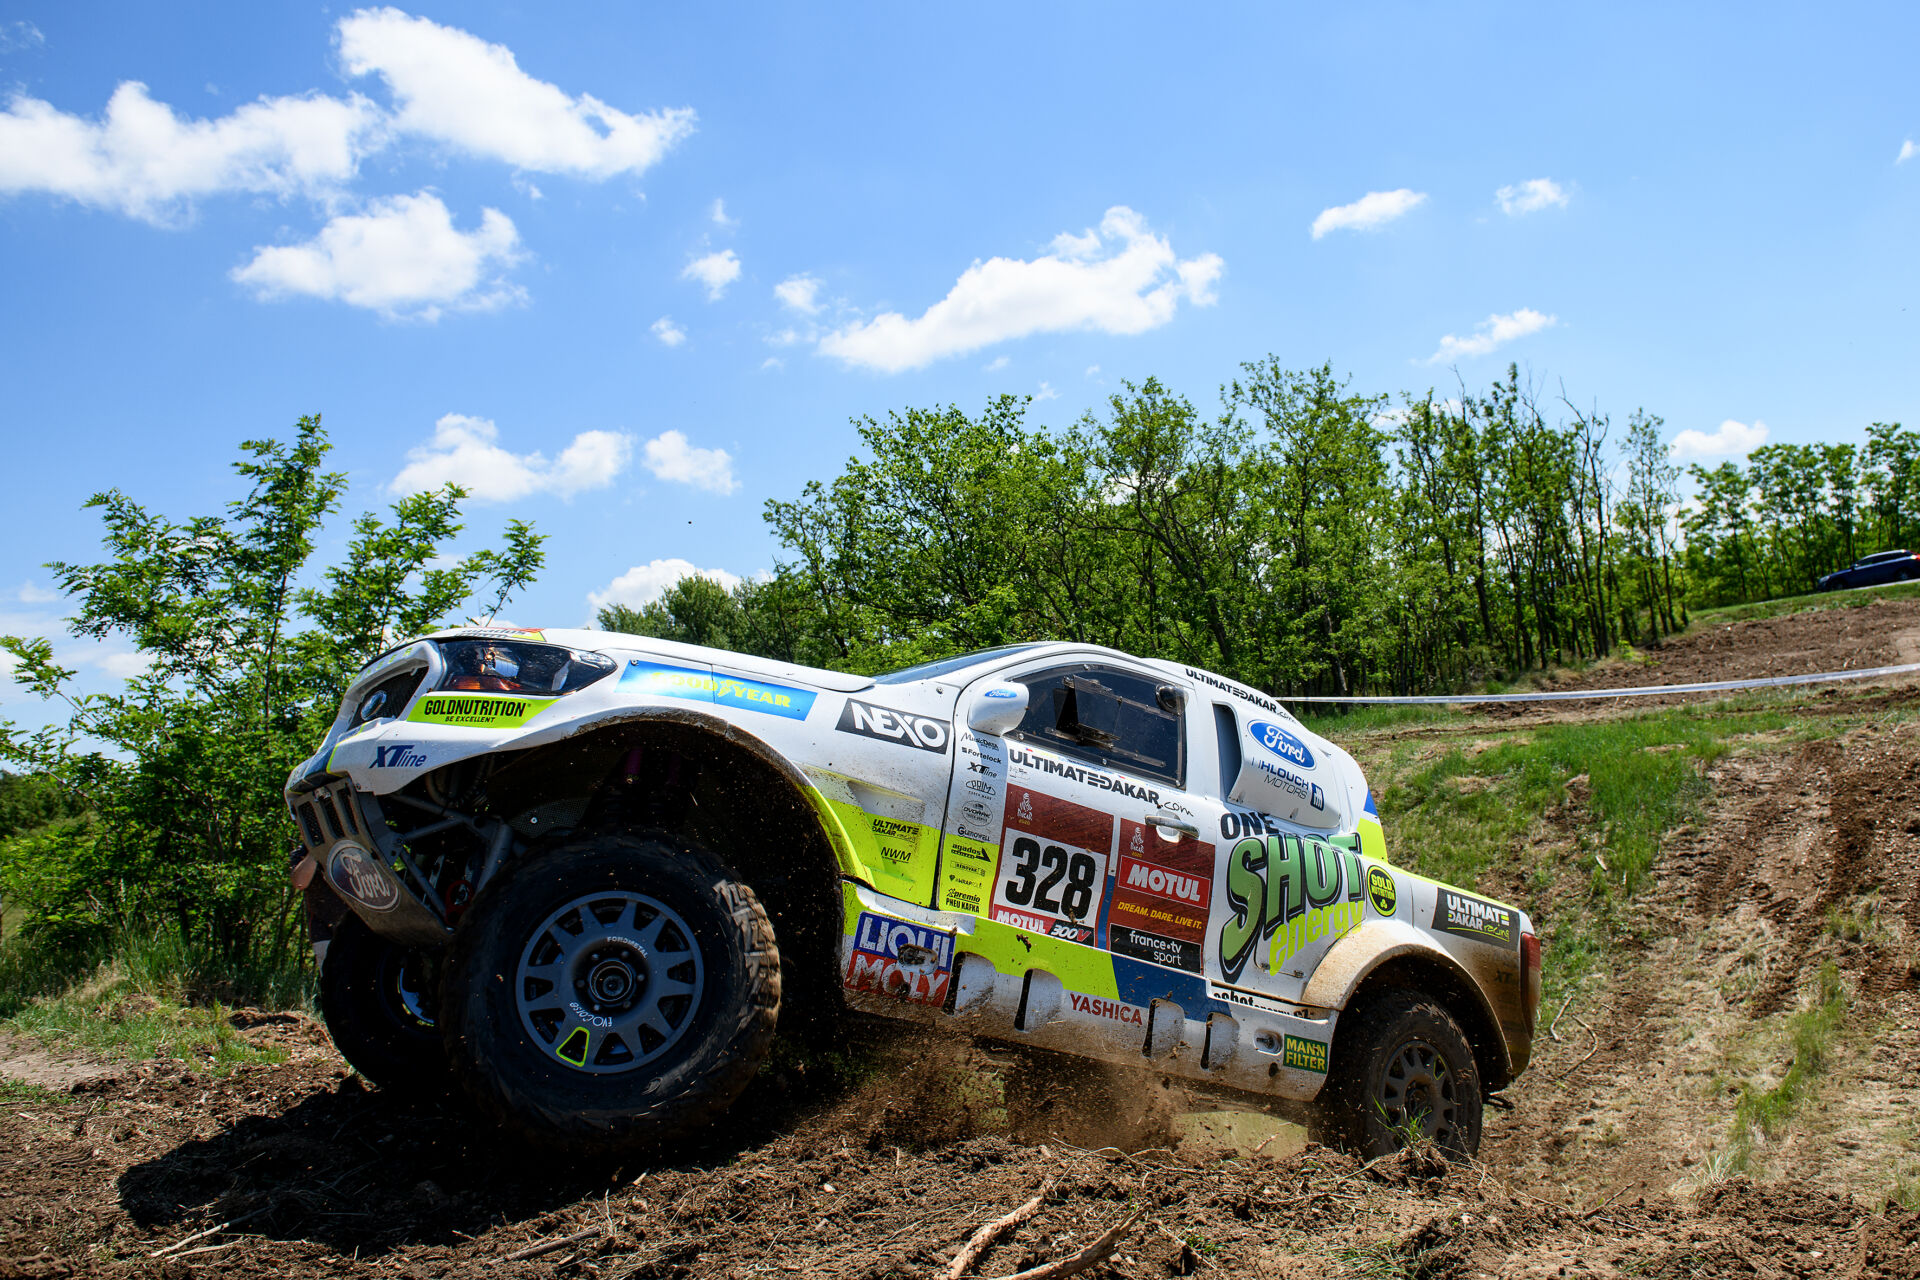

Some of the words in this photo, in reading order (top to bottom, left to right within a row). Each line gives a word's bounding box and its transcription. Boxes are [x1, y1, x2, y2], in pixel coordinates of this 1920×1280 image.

[424, 699, 526, 718] GOLDNUTRITION
[850, 698, 947, 749] NEXO
[968, 749, 1001, 764] Fortelock
[1263, 725, 1306, 763] Ford
[1264, 775, 1307, 800] MOTORS
[871, 826, 897, 837] DAKAR
[873, 818, 919, 836] ULTIMATE
[1220, 812, 1279, 840] ONE
[881, 846, 912, 862] NWM
[341, 853, 393, 899] Ford
[1005, 836, 1096, 920] 328
[1127, 863, 1201, 902] MOTUL
[1370, 873, 1393, 891] GOLD
[1117, 901, 1149, 916] DREAM.
[1149, 909, 1174, 922] DARE.
[1174, 915, 1192, 927] LIVE
[1192, 919, 1203, 930] IT.
[1219, 832, 1365, 984] SHOT
[1446, 893, 1510, 926] ULTIMATE
[1447, 909, 1483, 931] DAKAR
[996, 911, 1047, 935] MOTUL
[1050, 924, 1092, 943] 300V
[1269, 900, 1365, 977] energy
[859, 916, 951, 968] LIQUI
[1153, 950, 1182, 966] sport
[849, 954, 949, 1000] MOLY
[1069, 993, 1143, 1026] YASHICA
[1286, 1037, 1326, 1058] MANN
[1286, 1053, 1325, 1071] FILTER
